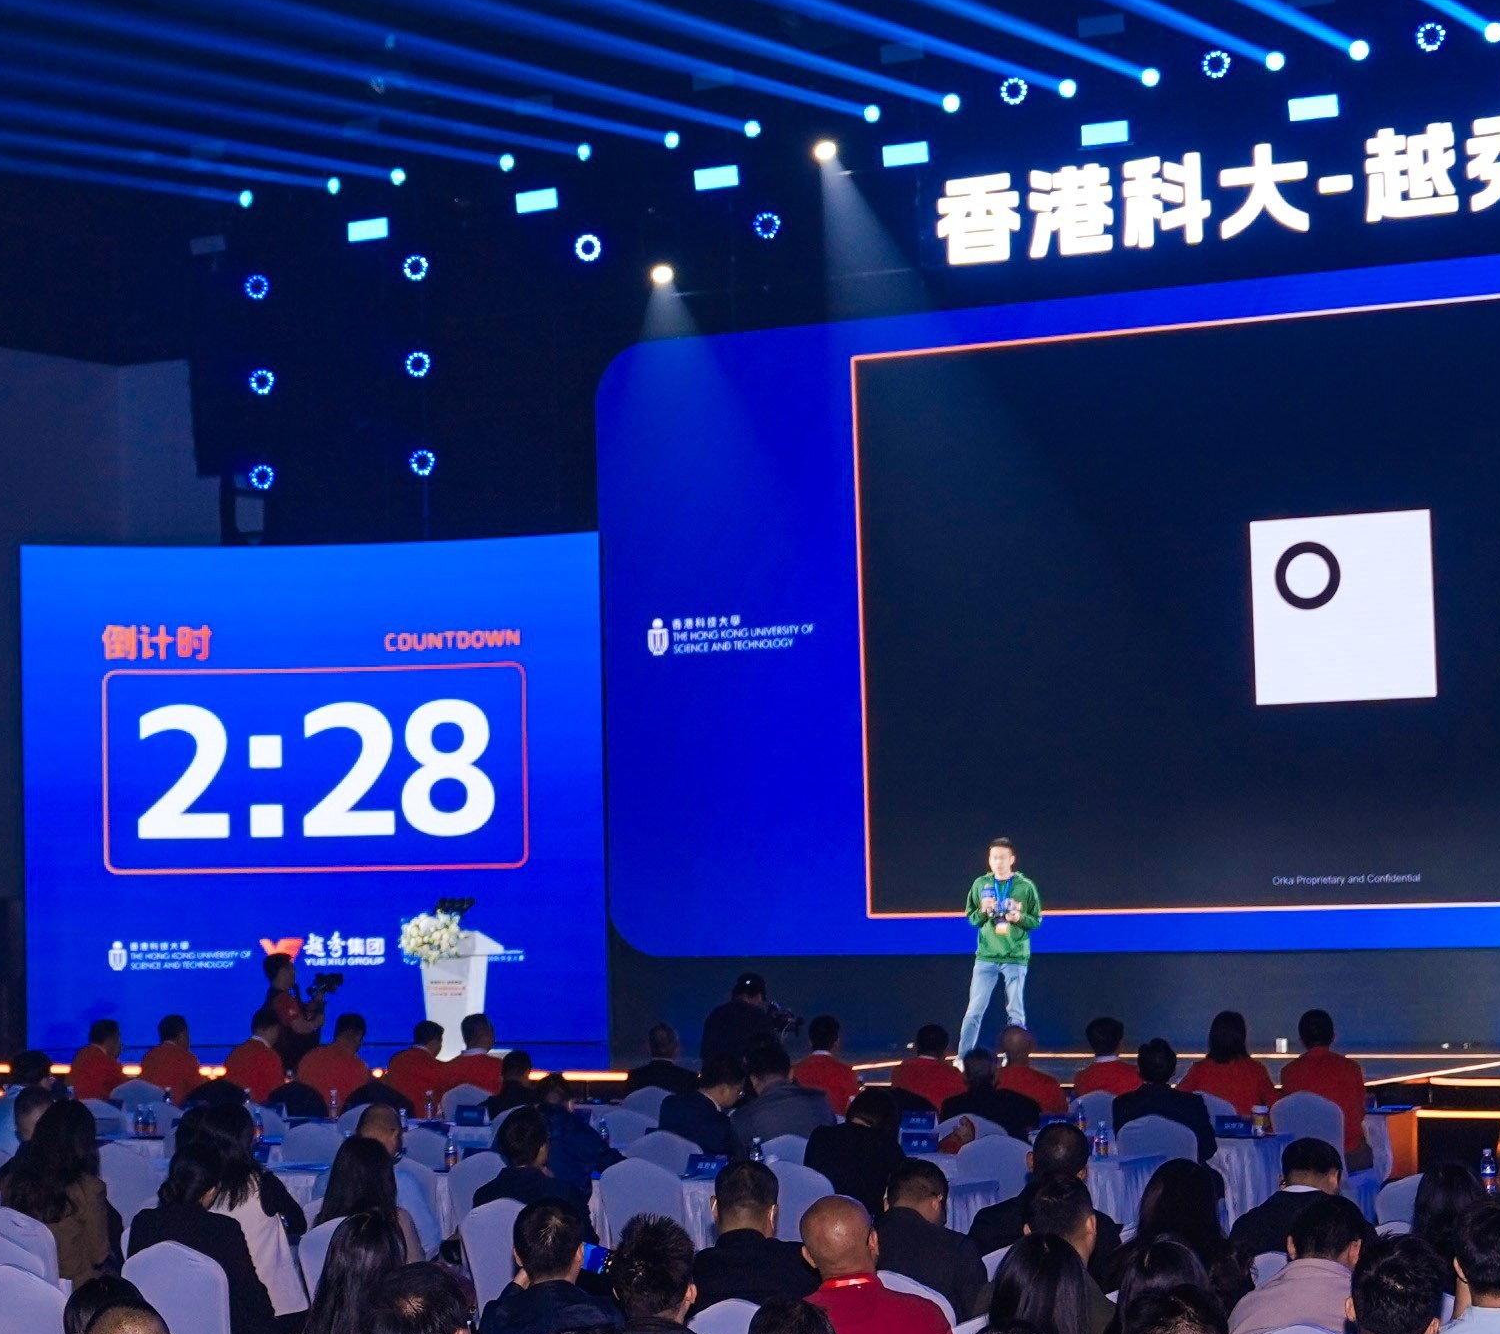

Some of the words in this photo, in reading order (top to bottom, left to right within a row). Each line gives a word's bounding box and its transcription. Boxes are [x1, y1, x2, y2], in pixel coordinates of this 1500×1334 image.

[383, 628, 522, 653] COUNTDOWN
[673, 631, 688, 642] THE
[690, 630, 718, 641] HONG
[720, 628, 749, 639] KONG
[750, 624, 799, 637] UNIVERSITY
[801, 623, 814, 634] OF
[102, 623, 213, 662] 倒计时
[673, 642, 709, 654] SCIENCE
[711, 640, 732, 652] AND
[733, 637, 794, 650] TECHNOLOGY
[137, 698, 496, 839] 2:28
[1272, 876, 1294, 886] Orka
[1296, 874, 1345, 887] Proprietary
[1347, 875, 1365, 884] and
[1367, 872, 1421, 884] Confidential
[304, 956, 345, 967] YUEXIU
[346, 956, 386, 966] GROUP
